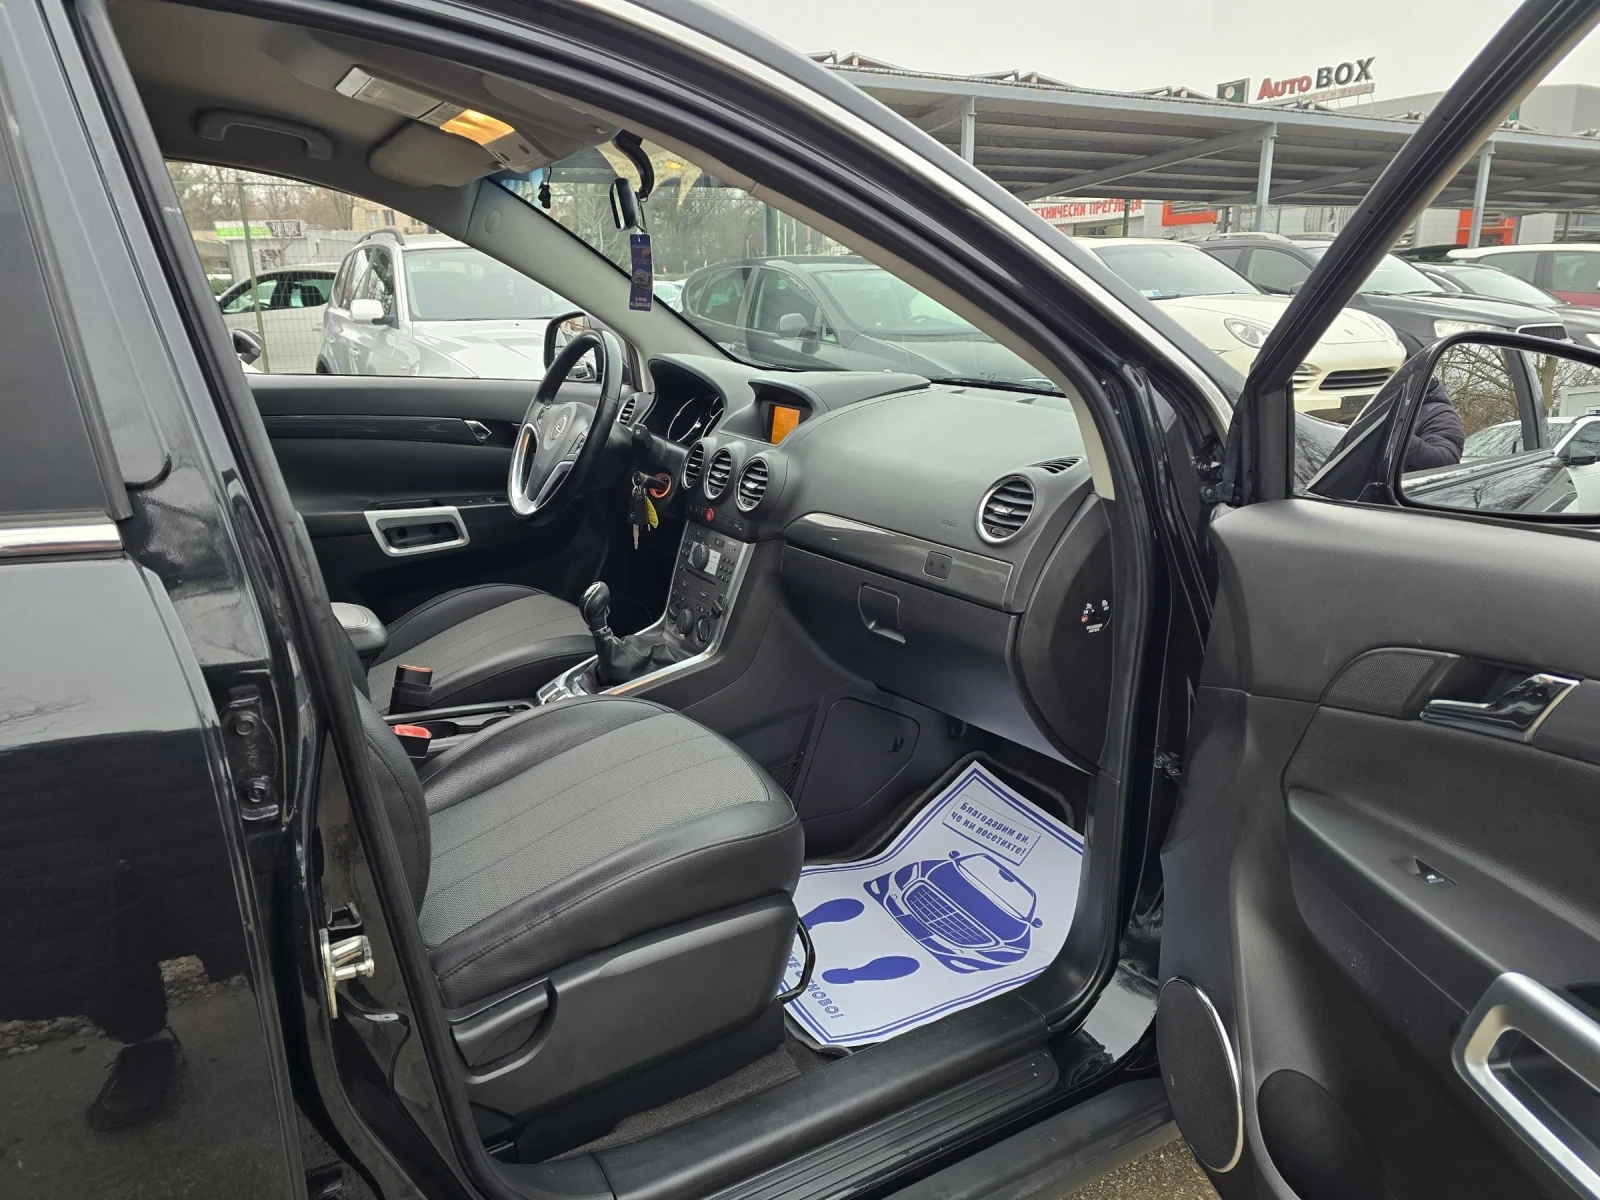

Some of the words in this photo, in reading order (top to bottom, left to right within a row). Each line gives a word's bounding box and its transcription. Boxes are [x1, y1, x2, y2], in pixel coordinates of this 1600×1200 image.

[1257, 75, 1312, 100] AUTO
[1315, 56, 1376, 89] BOX
[951, 811, 963, 823] че
[962, 819, 976, 831] ни
[976, 826, 1027, 856] посетихте!
[960, 802, 1016, 837] Благодарим
